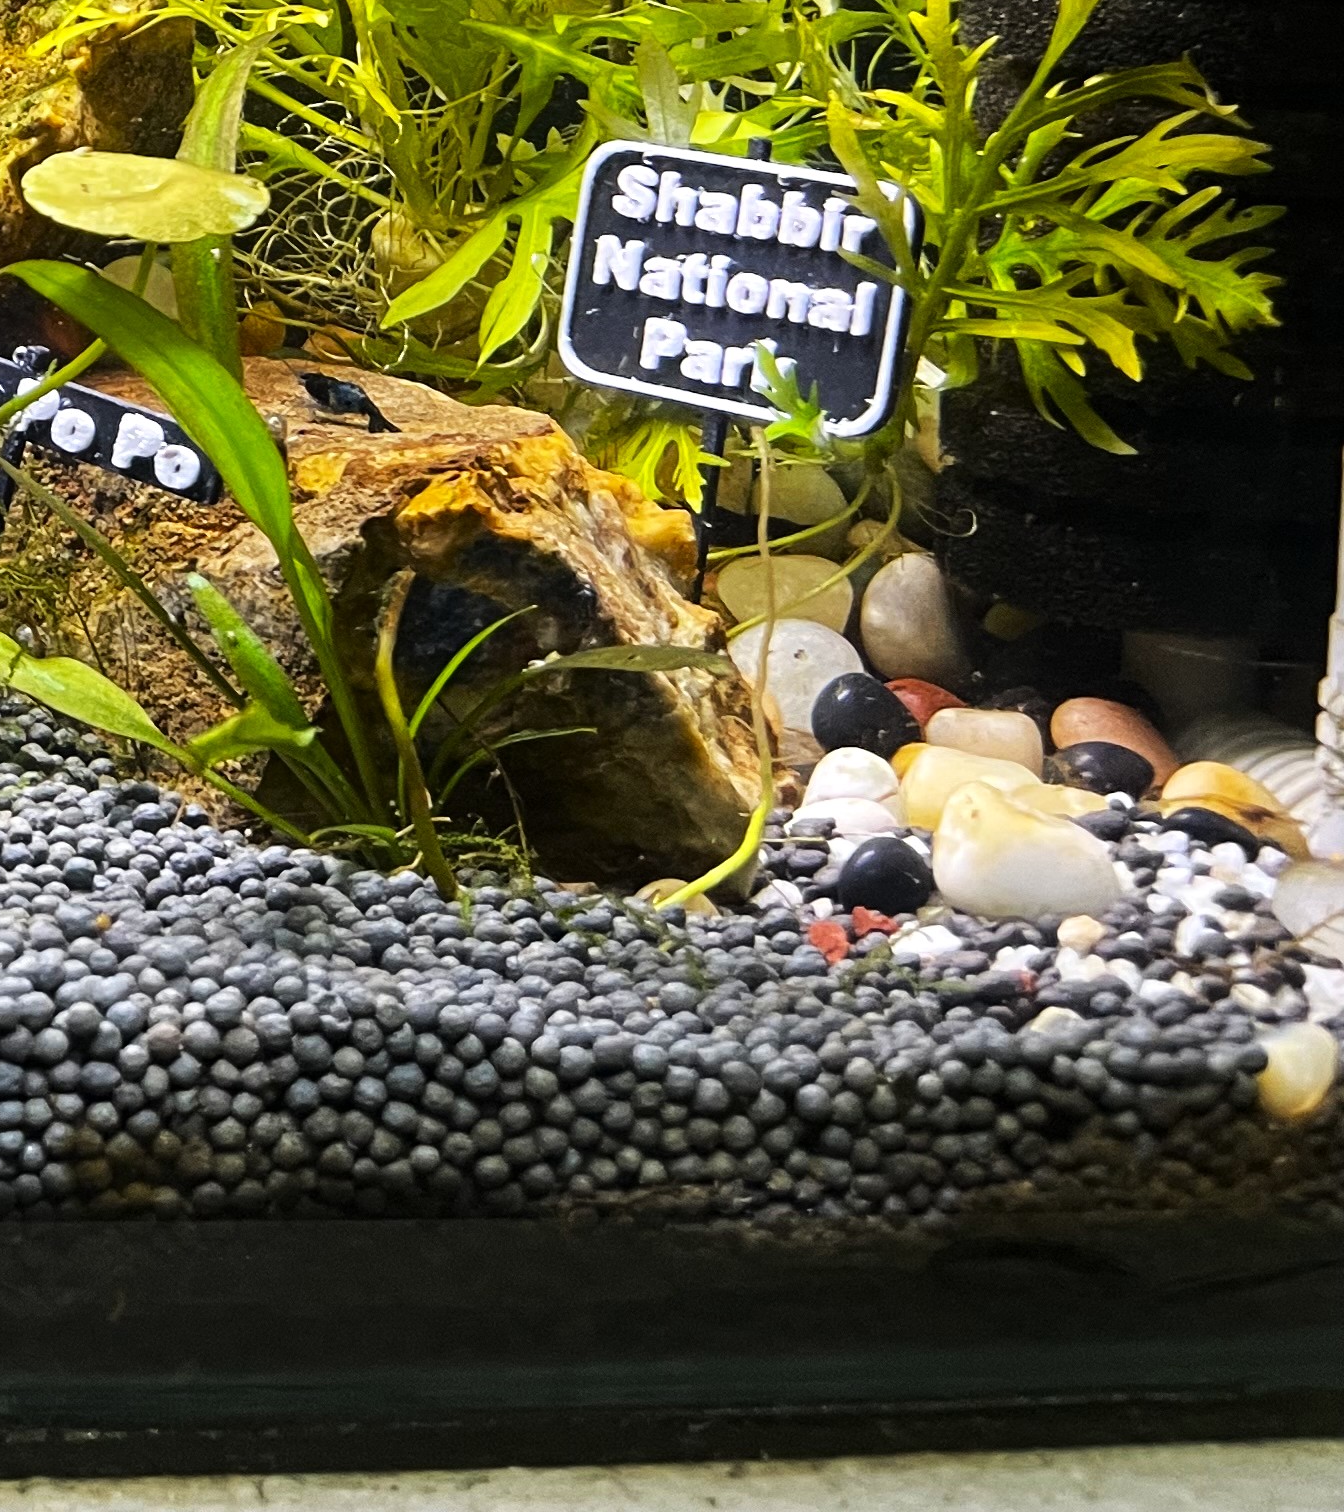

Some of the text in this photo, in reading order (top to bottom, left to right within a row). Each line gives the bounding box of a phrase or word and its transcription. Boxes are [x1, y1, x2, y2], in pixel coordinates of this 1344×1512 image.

[612, 164, 878, 254] Shabbir
[592, 234, 879, 337] National
[111, 412, 202, 491] Po
